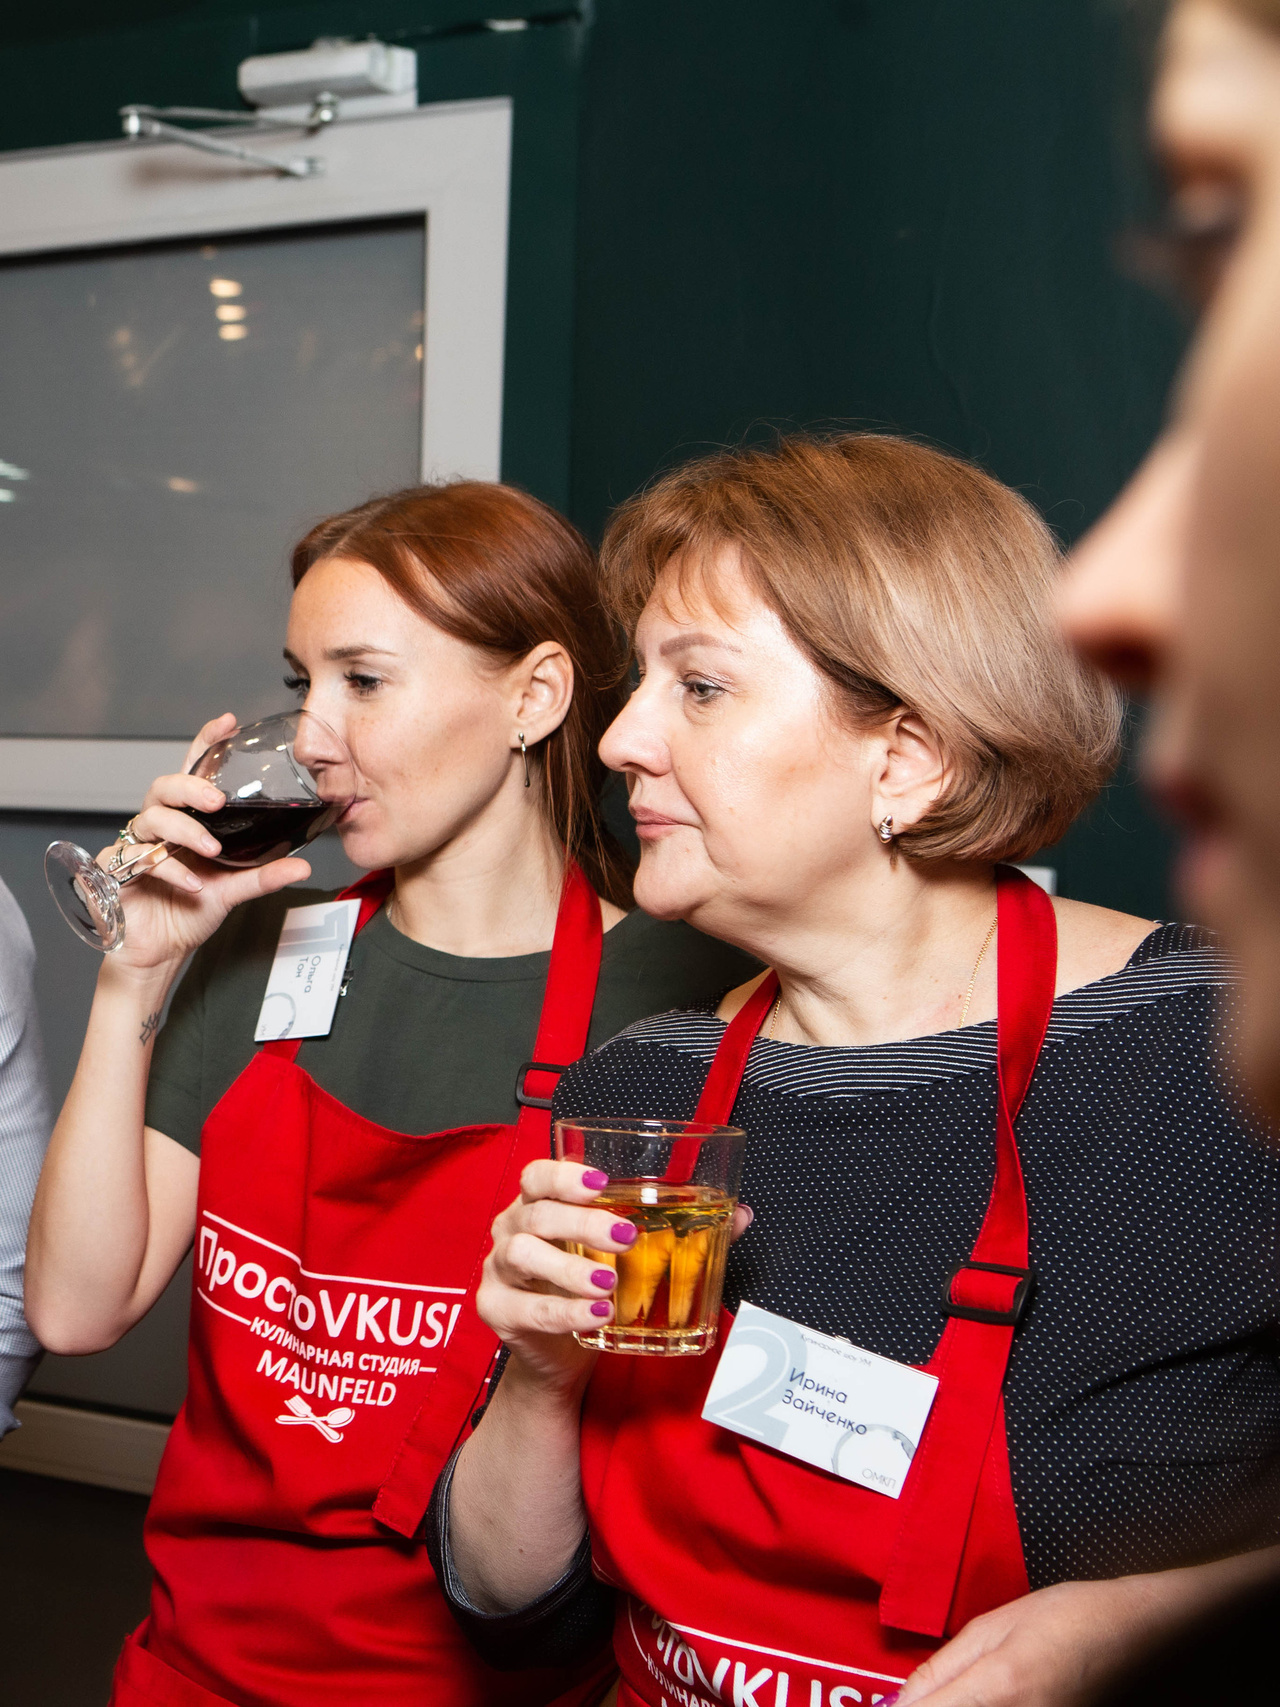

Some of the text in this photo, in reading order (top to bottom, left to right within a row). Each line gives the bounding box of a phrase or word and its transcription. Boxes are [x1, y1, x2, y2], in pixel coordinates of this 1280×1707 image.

[303, 955, 322, 993] Ольга
[249, 1316, 420, 1379] КУЛИНАРНАЯ СТУДИЯ
[255, 1349, 397, 1407] MAUNFELD
[788, 1367, 848, 1404] Ирина
[781, 1388, 868, 1435] Зайченко
